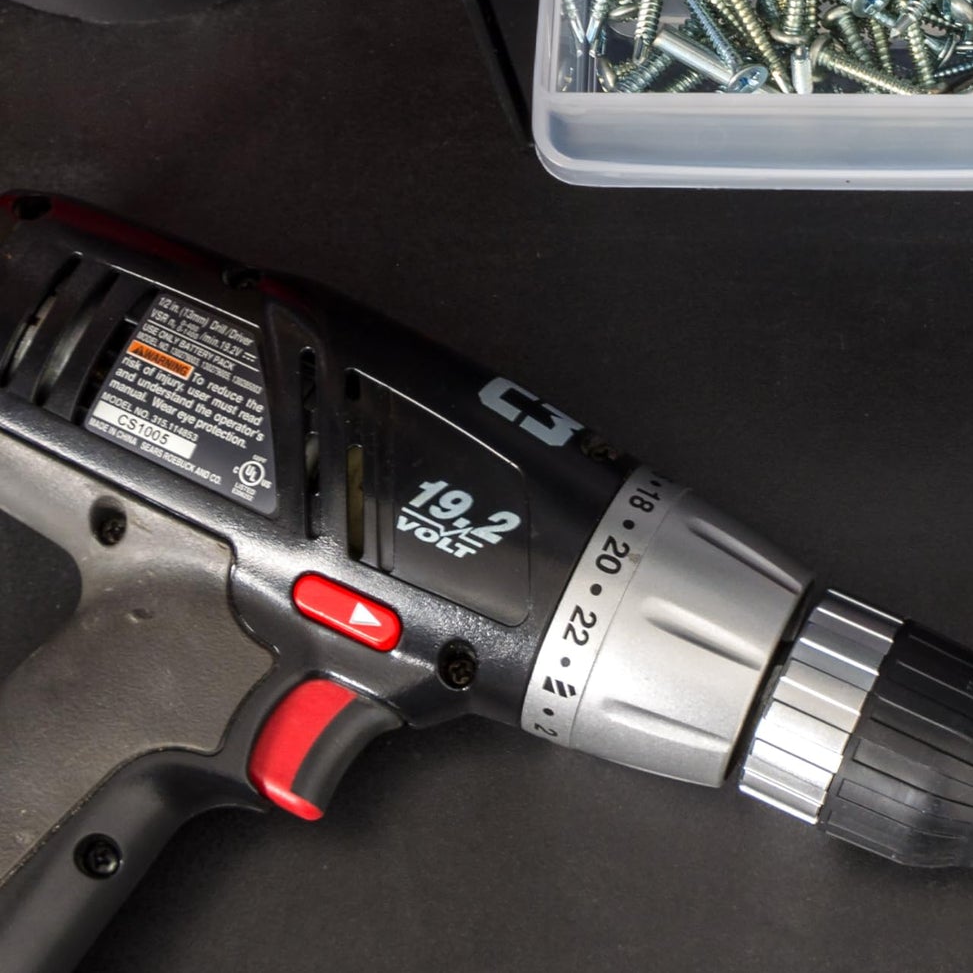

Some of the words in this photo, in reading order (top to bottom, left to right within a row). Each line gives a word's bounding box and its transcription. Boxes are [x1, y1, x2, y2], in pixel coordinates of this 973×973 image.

[151, 309, 169, 322] VSR
[159, 297, 172, 309] 1/2
[179, 307, 210, 327] (13mm)
[142, 323, 159, 336] USE
[158, 330, 180, 344] ONLY
[178, 340, 214, 360] BATTERY
[213, 355, 235, 371] PACK
[143, 350, 188, 376] WARNING
[101, 392, 132, 412] MODEL
[134, 407, 149, 420] NO.
[115, 368, 137, 382] and
[137, 378, 195, 409] understand
[195, 403, 212, 417] the
[213, 413, 264, 441] operator's
[121, 356, 142, 371] risk
[143, 366, 156, 376] of
[187, 387, 211, 401] user
[211, 398, 238, 415] must
[238, 410, 263, 426] read
[192, 372, 205, 385] To
[207, 382, 244, 403] reduce
[245, 398, 264, 413] the
[89, 418, 109, 432] MADE
[108, 427, 117, 436] IN
[116, 430, 137, 445] CHINA
[109, 379, 147, 402] manual.
[152, 396, 178, 415] Wear
[177, 411, 196, 424] eye
[194, 419, 246, 448] protection.
[117, 414, 170, 445] CS1005
[140, 442, 164, 458] SEARS
[162, 452, 195, 472] ROEBUCK
[194, 467, 210, 479] AND
[209, 474, 221, 485] CO.
[408, 480, 522, 544] 19.2
[629, 487, 660, 513] 18
[396, 515, 477, 558] VOLT
[595, 535, 630, 575] 20
[563, 604, 597, 646] 22
